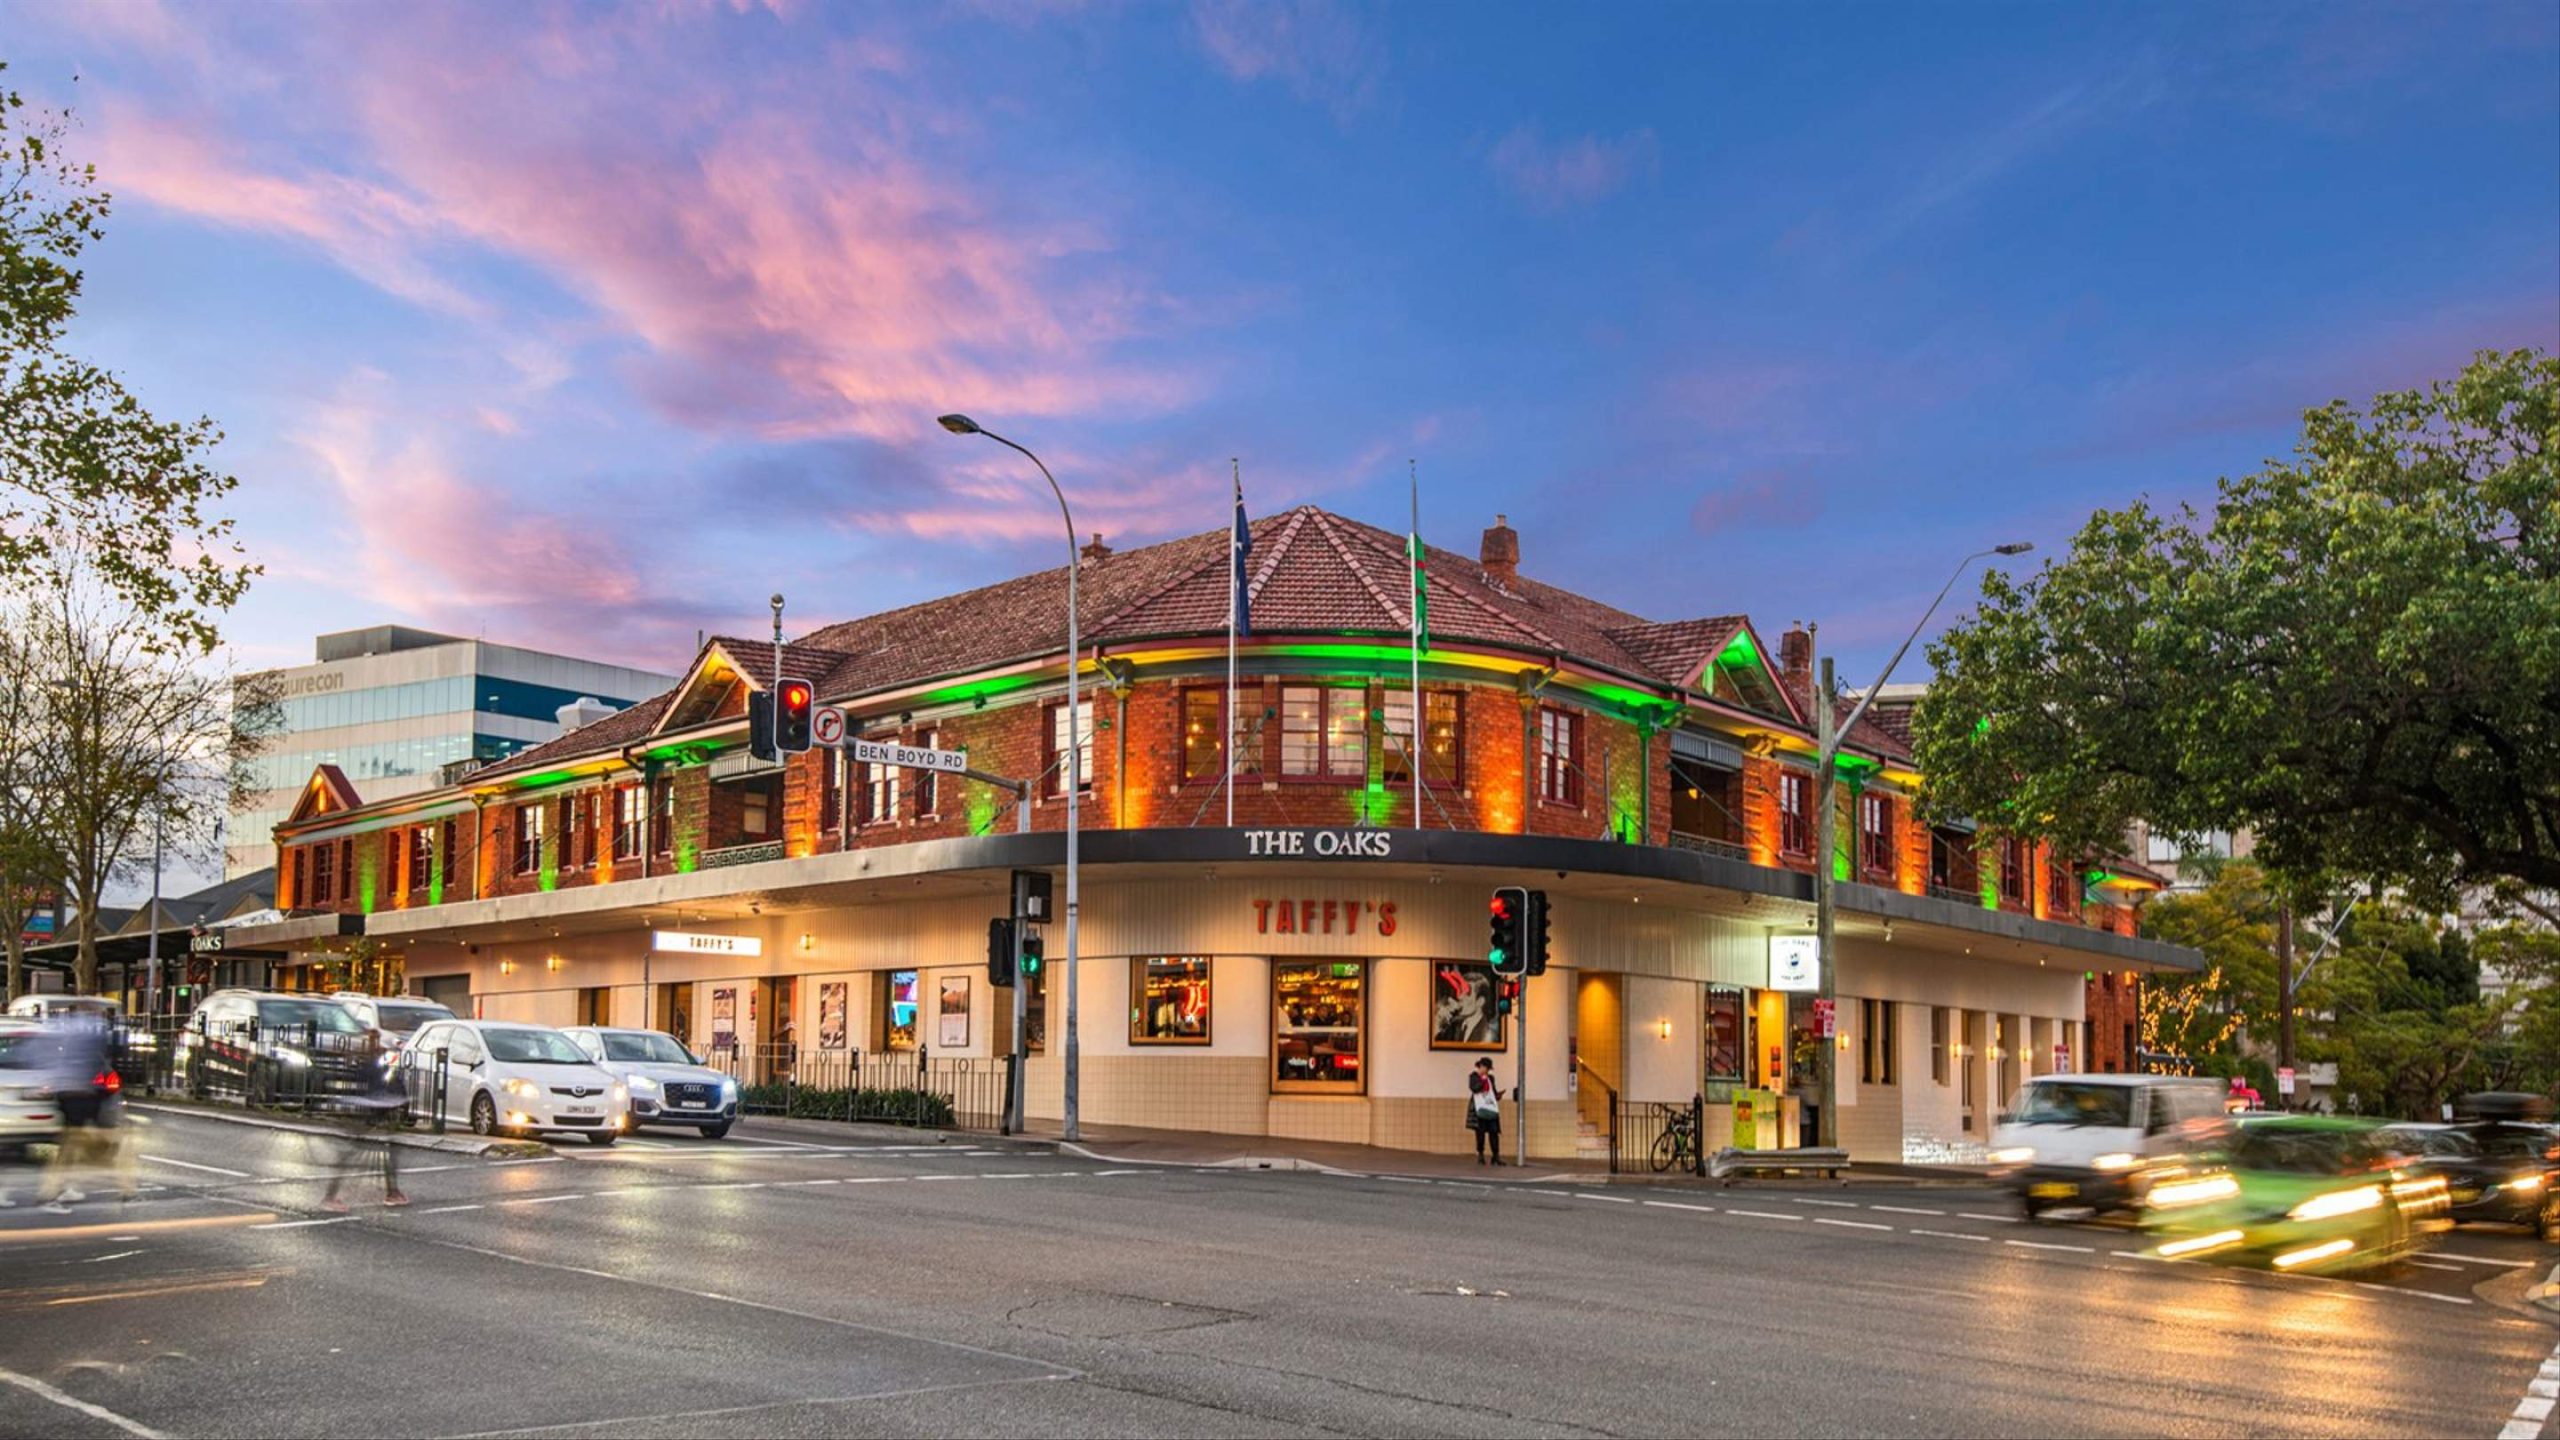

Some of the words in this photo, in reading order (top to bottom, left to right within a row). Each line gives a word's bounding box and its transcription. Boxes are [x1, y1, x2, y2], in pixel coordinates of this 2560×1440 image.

[859, 744, 889, 760] BEN
[896, 749, 937, 765] BOYD
[944, 755, 963, 768] RD
[1245, 830, 1304, 855] THE
[1314, 830, 1392, 857] OAKS
[1252, 899, 1398, 937] TAFFY'S
[690, 937, 734, 951] TAFFY'S
